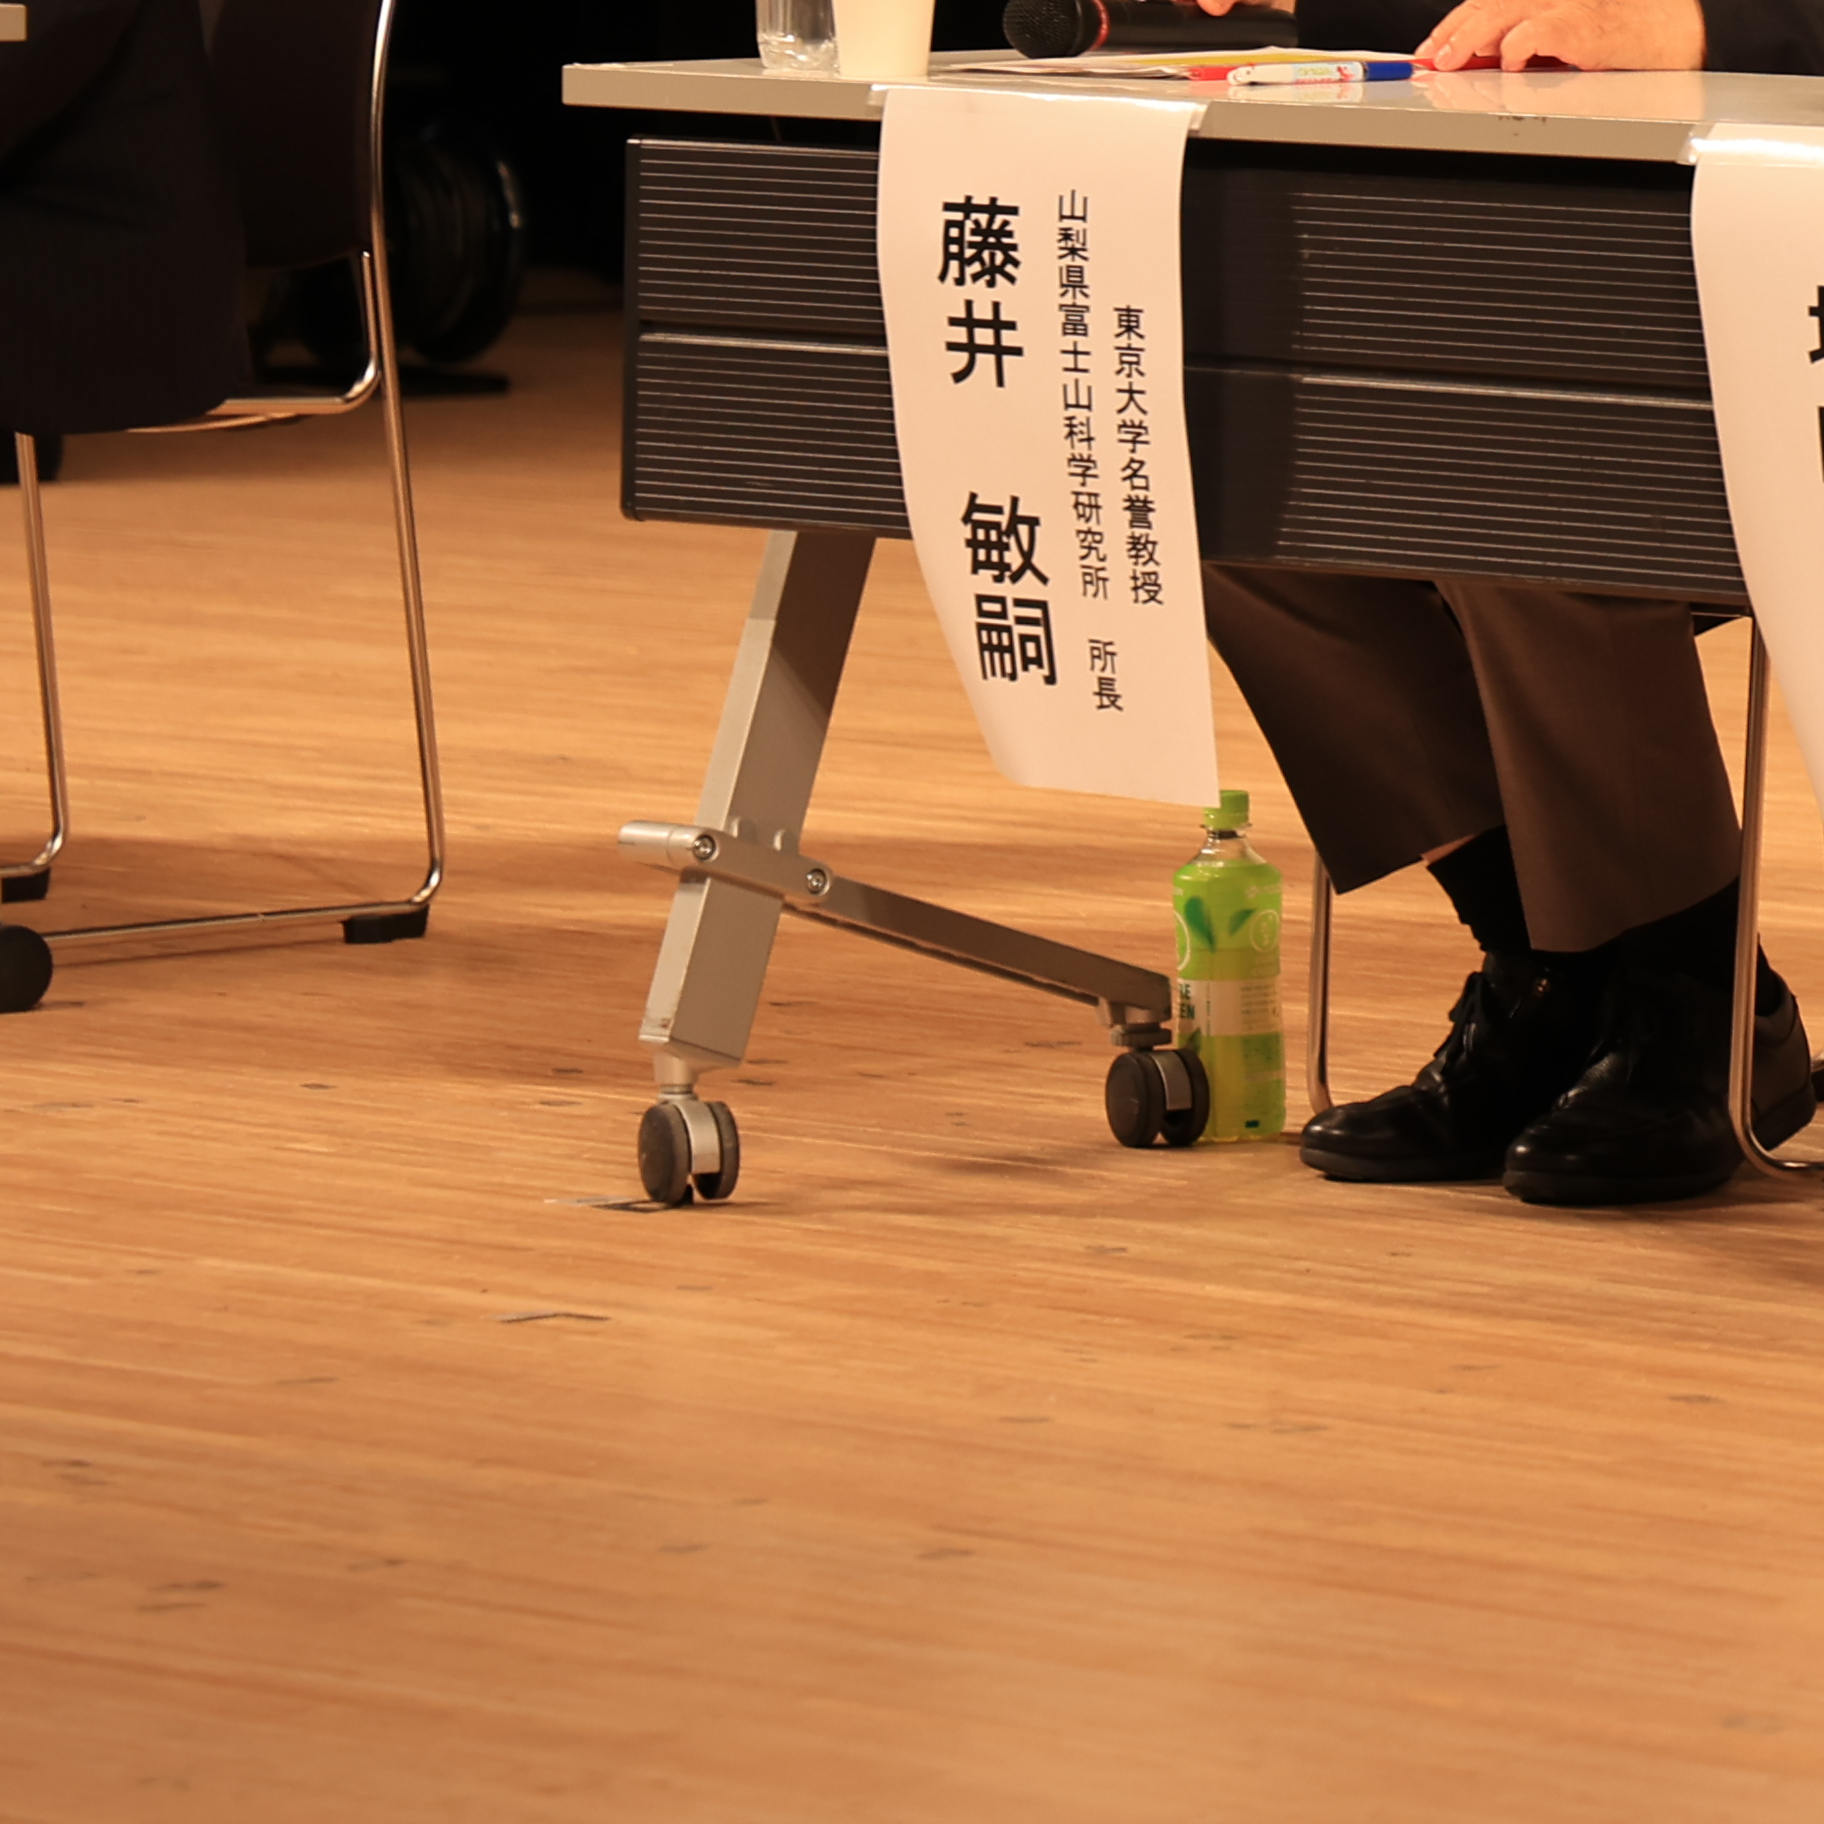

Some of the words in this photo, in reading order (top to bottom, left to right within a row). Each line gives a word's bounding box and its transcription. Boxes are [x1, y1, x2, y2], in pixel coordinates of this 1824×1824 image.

[936, 194, 1025, 389] 藤井
[1056, 189, 1110, 600] 山梨県富士山科学研究所
[1087, 638, 1124, 712] 所長
[1112, 304, 1164, 606] 東京大学名誉教授
[960, 490, 1058, 687] 敏嗣
